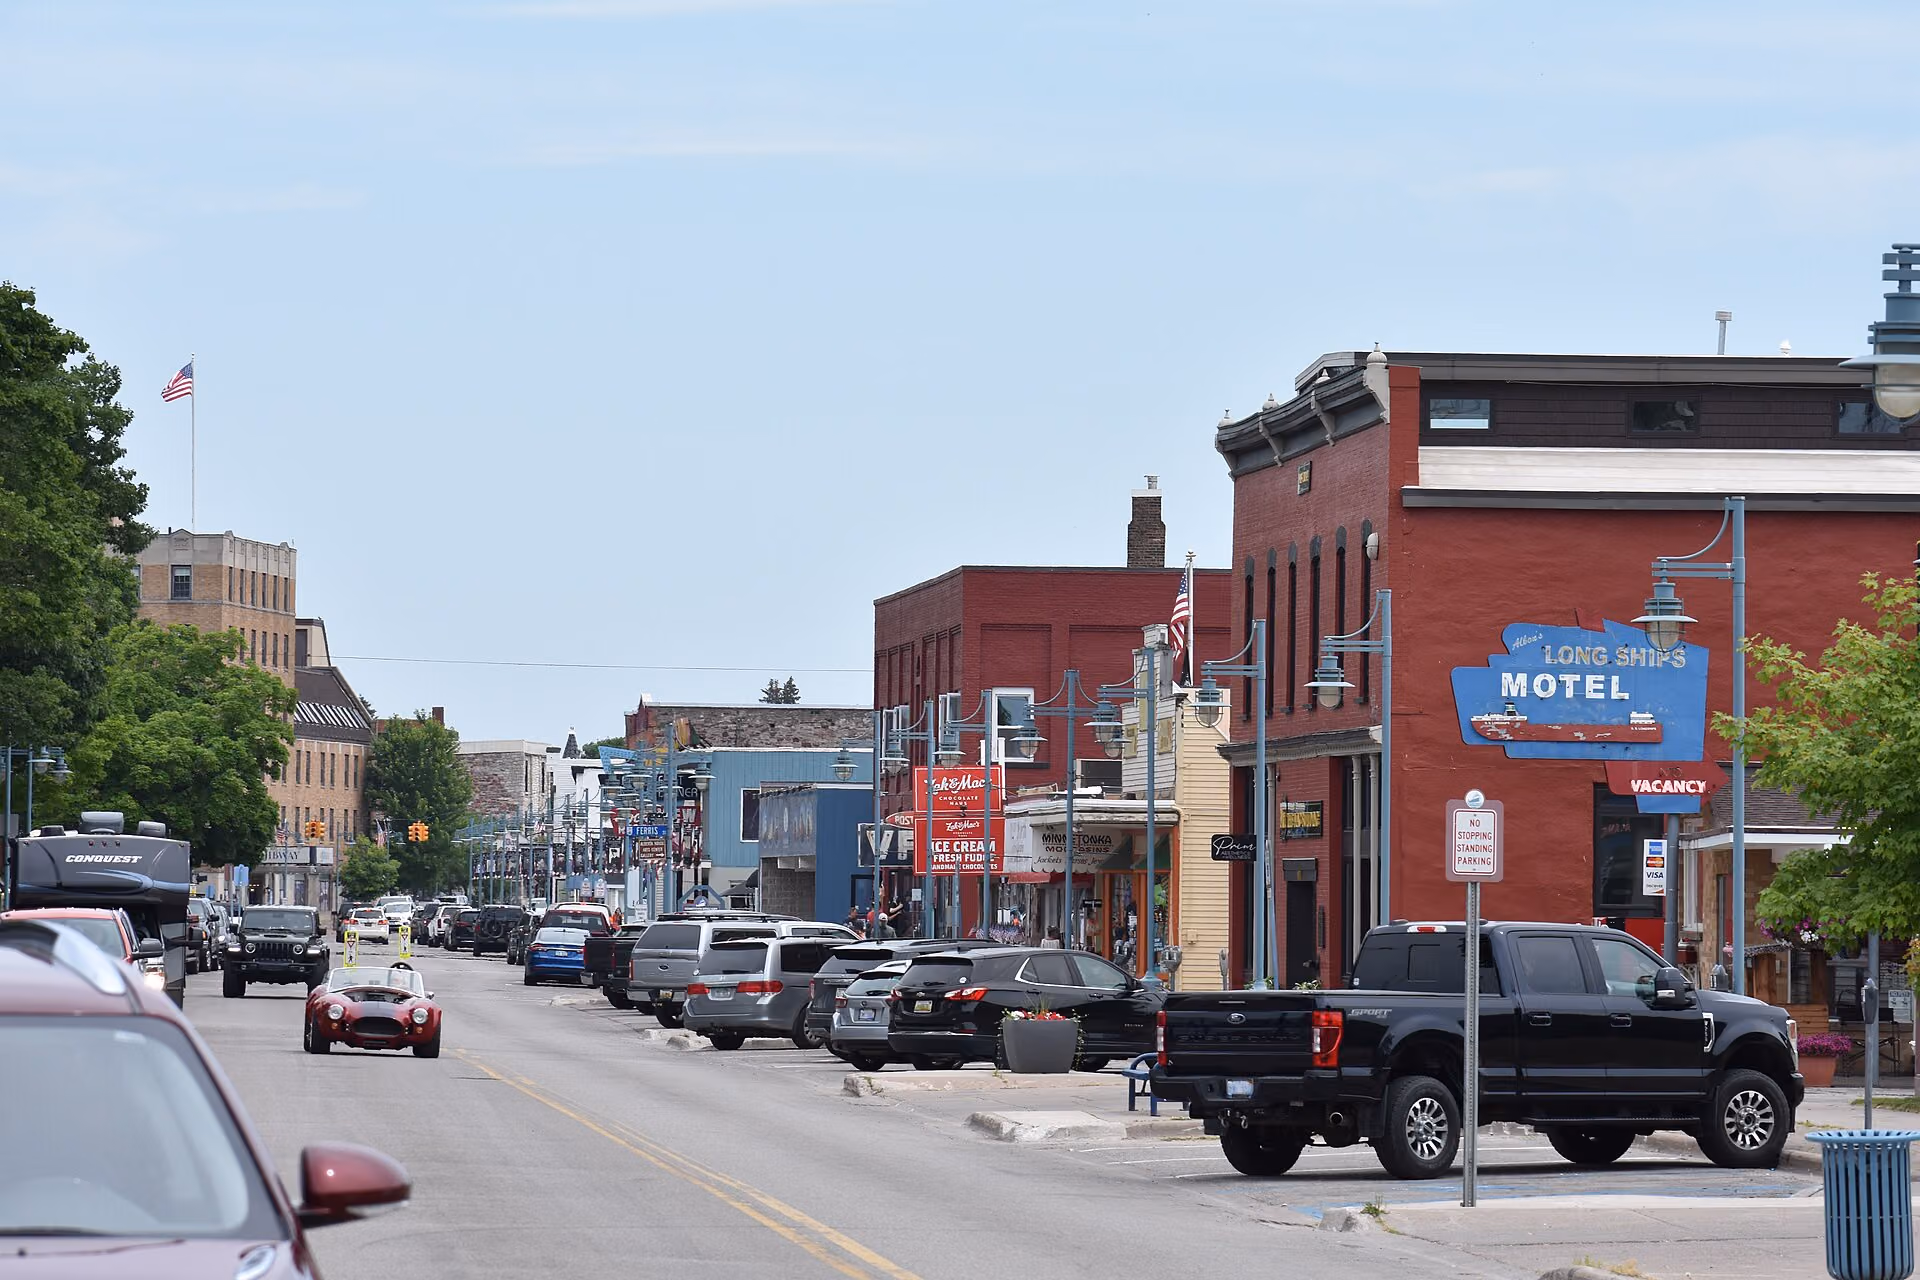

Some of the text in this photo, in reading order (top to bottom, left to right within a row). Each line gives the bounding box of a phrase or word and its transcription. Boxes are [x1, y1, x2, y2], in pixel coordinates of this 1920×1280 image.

[1544, 645, 1687, 668] LONG SHIPS
[1501, 672, 1630, 700] MOTEL
[1630, 779, 1707, 793] VACANCY
[1469, 819, 1481, 828] NO
[1457, 832, 1493, 841] STOPPING
[931, 840, 996, 852] ICE CREAM
[1456, 844, 1493, 853] STANDING
[65, 855, 142, 863] CONQUEST
[933, 854, 994, 862] FRESH FUDE
[1457, 857, 1492, 866] PARKING
